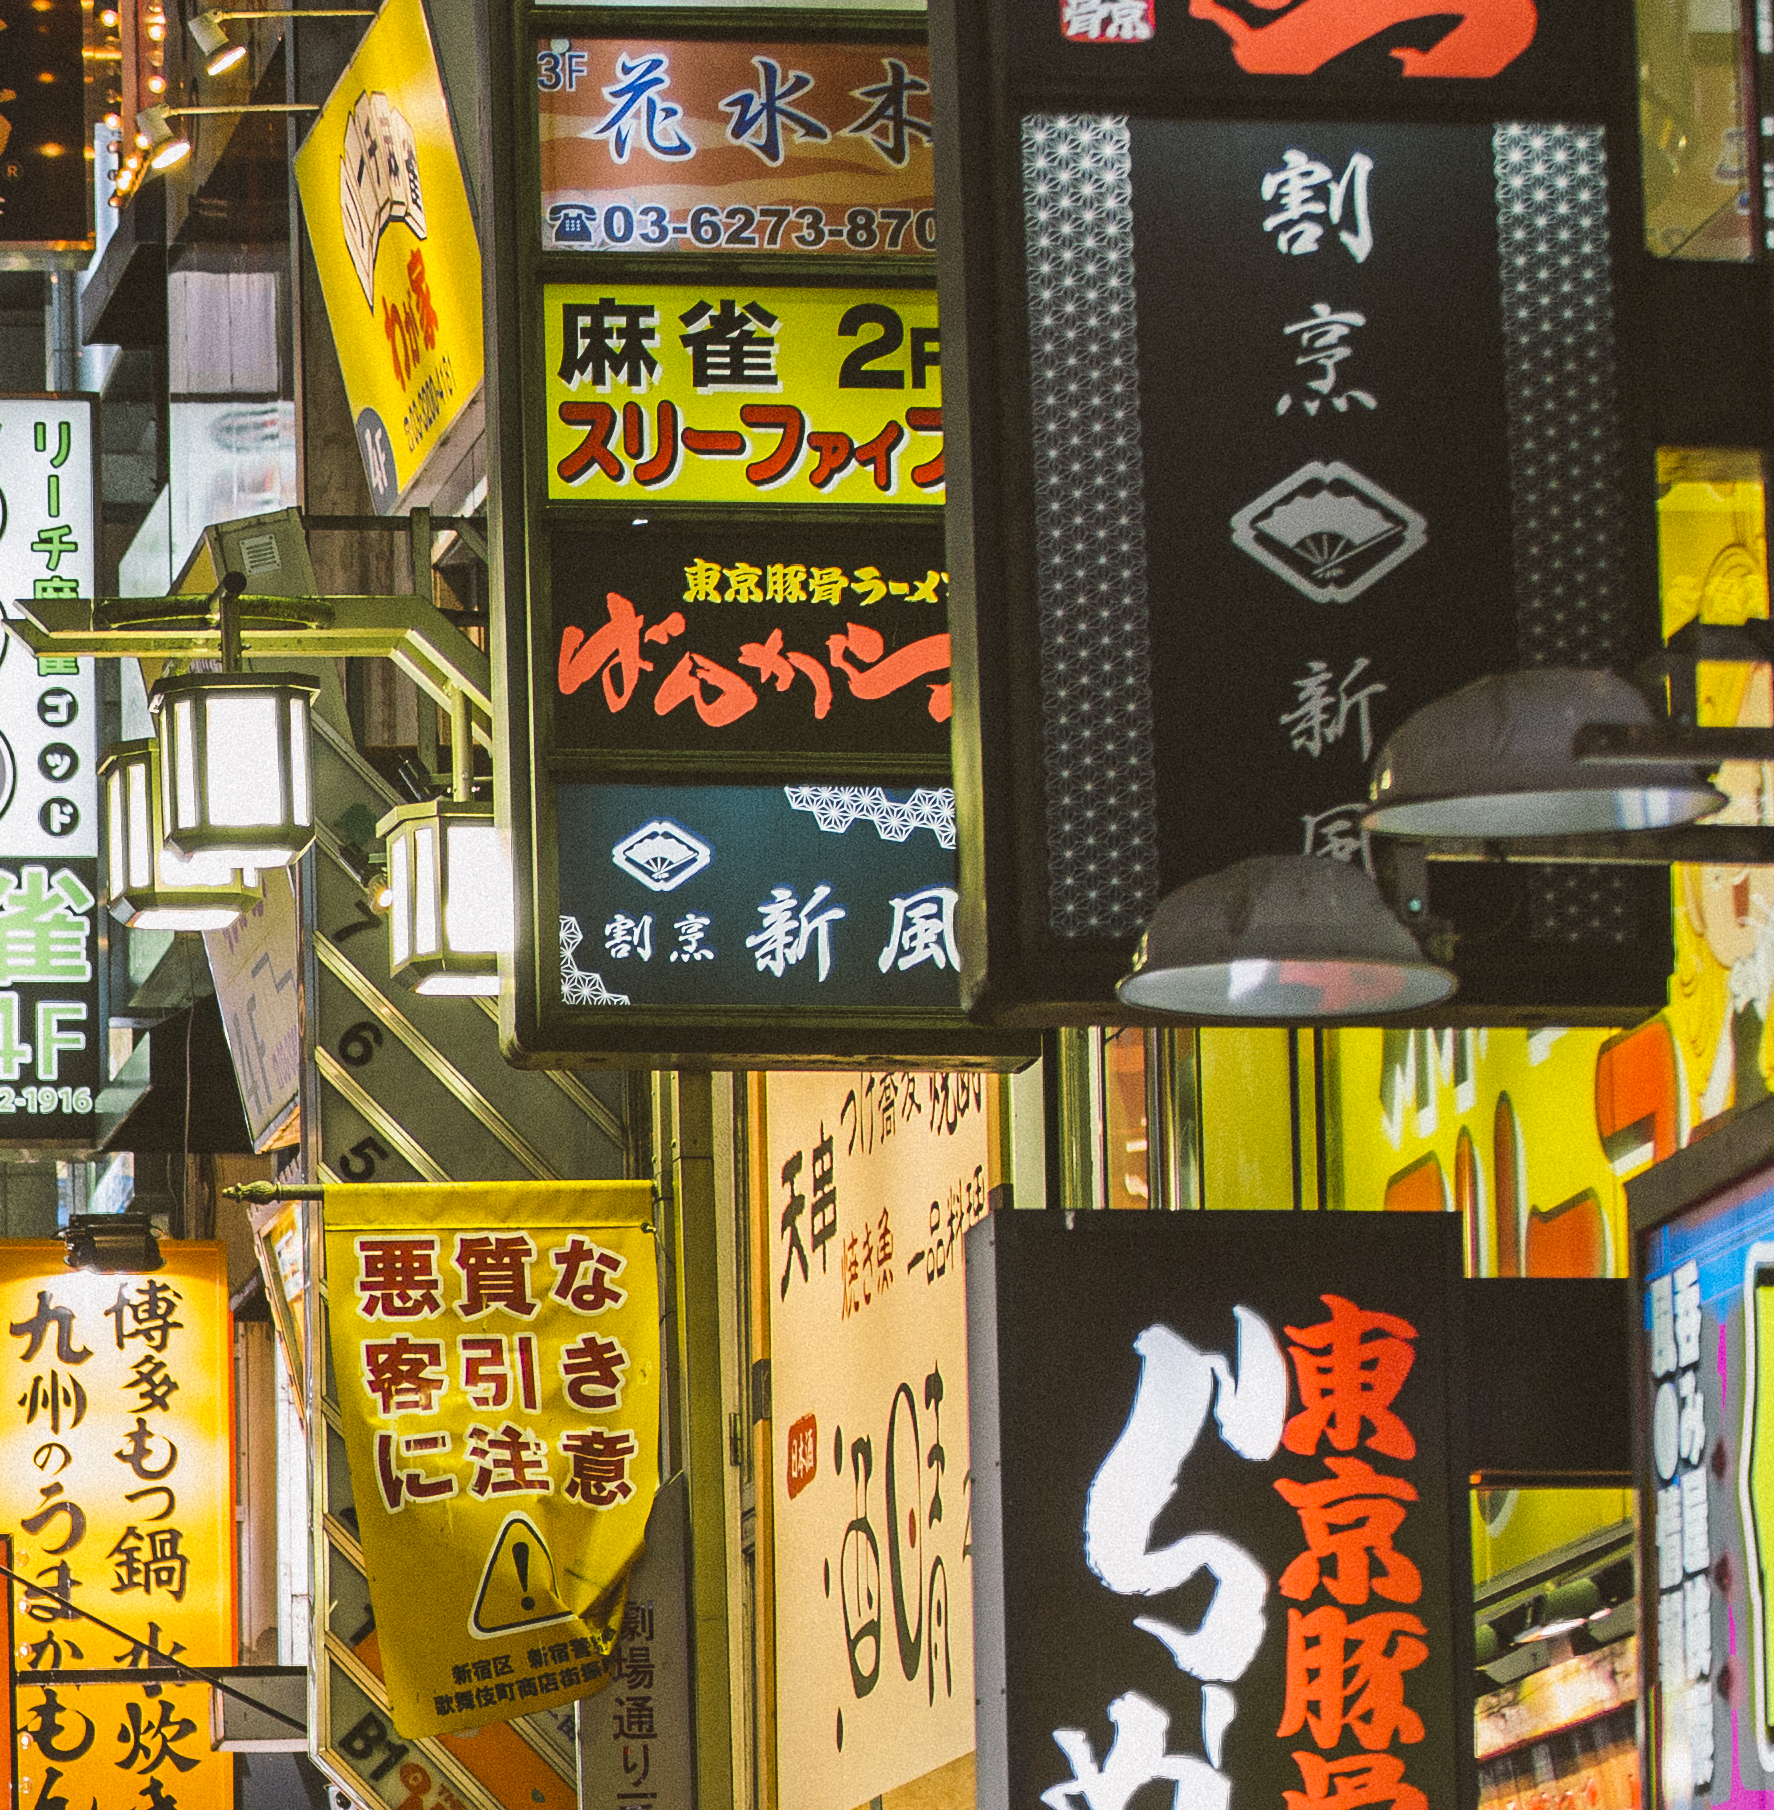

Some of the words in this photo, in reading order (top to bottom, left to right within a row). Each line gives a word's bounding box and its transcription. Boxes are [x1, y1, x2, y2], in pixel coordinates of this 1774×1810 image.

[537, 50, 587, 92] 3F
[592, 50, 935, 167] 花水木
[1260, 148, 1378, 417] 割烹
[556, 298, 782, 390] 麻雀
[362, 422, 388, 496] 4F
[37, 687, 81, 839] ゴッド
[603, 912, 716, 963] 割烹
[746, 883, 961, 983] 新風
[337, 1020, 385, 1066] 6
[337, 1136, 389, 1182] 5
[842, 1205, 895, 1322] 焼き魚
[906, 1164, 992, 1286] 一品料理
[356, 1235, 627, 1324] 悪質な
[364, 1334, 632, 1418] 客引き
[104, 1279, 191, 1602] 博多もつ鍋
[374, 1426, 639, 1513] に注意
[339, 1718, 405, 1782] B1
